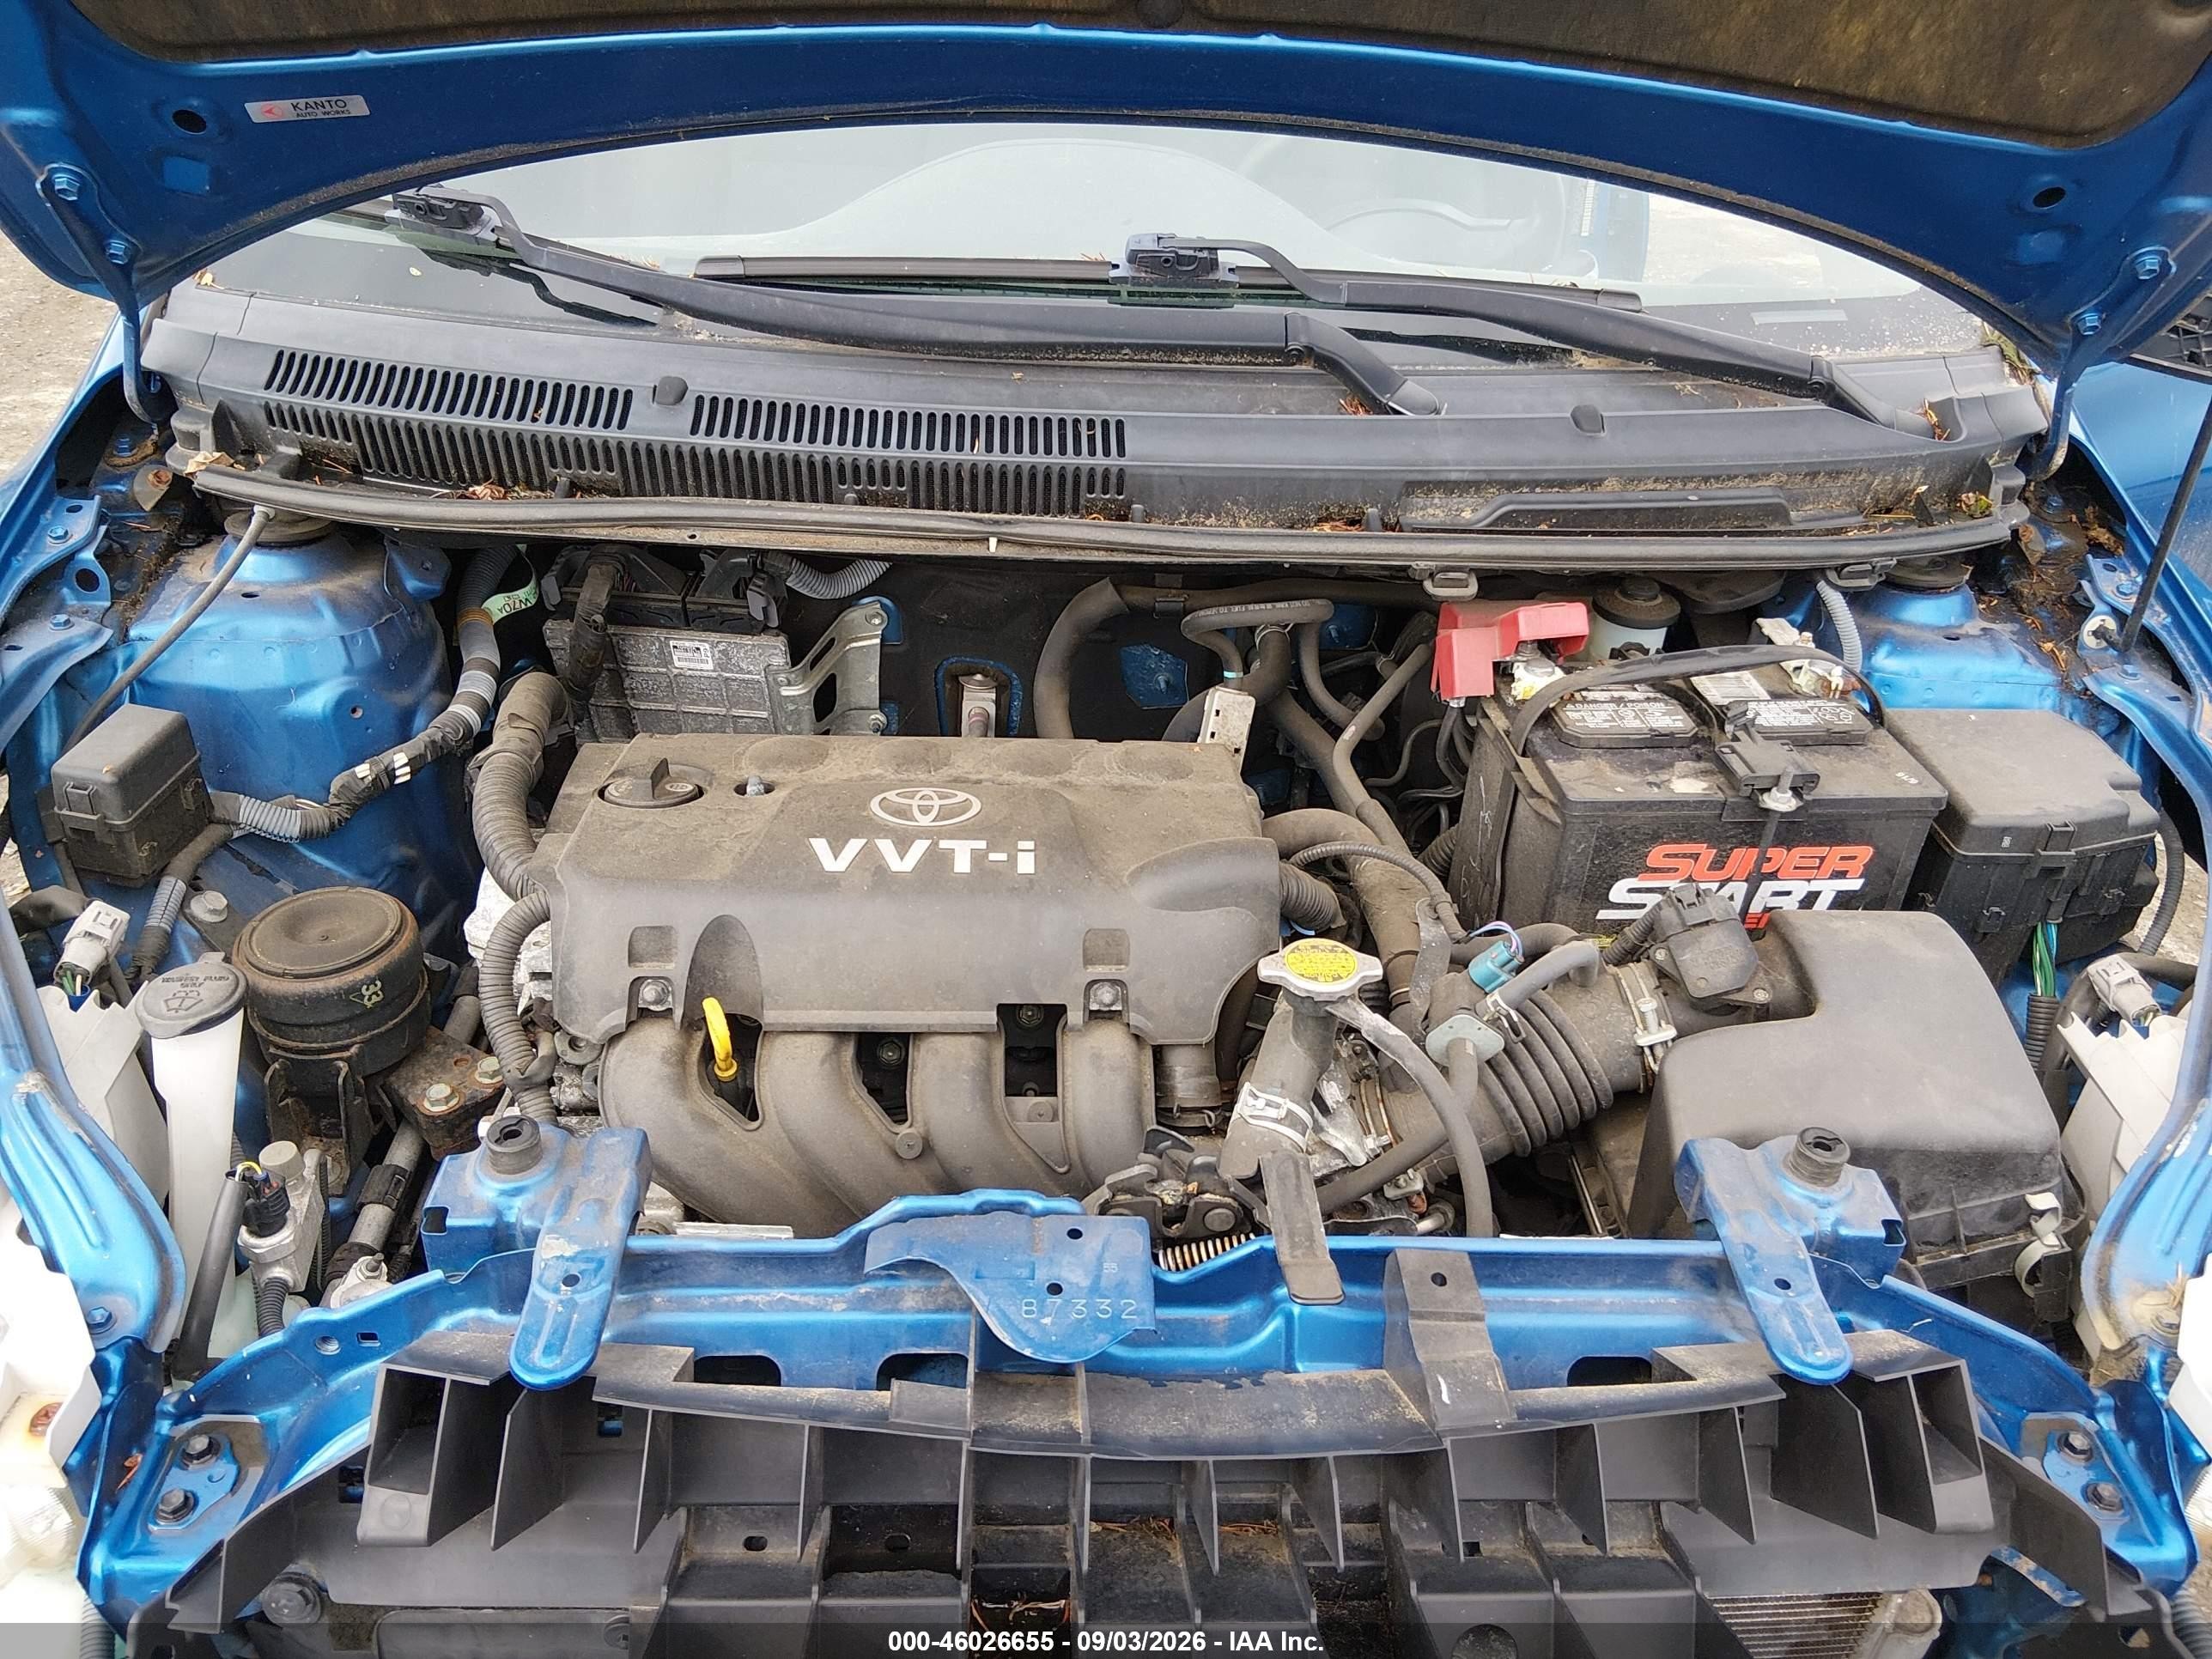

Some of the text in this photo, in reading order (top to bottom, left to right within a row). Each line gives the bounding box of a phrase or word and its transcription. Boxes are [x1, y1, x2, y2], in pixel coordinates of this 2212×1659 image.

[290, 99, 347, 112] KANTO
[808, 837, 1036, 874] VVT-i
[1637, 843, 1875, 881] SUPER
[1595, 878, 1866, 921] SART
[1021, 1298, 1138, 1319] 87332
